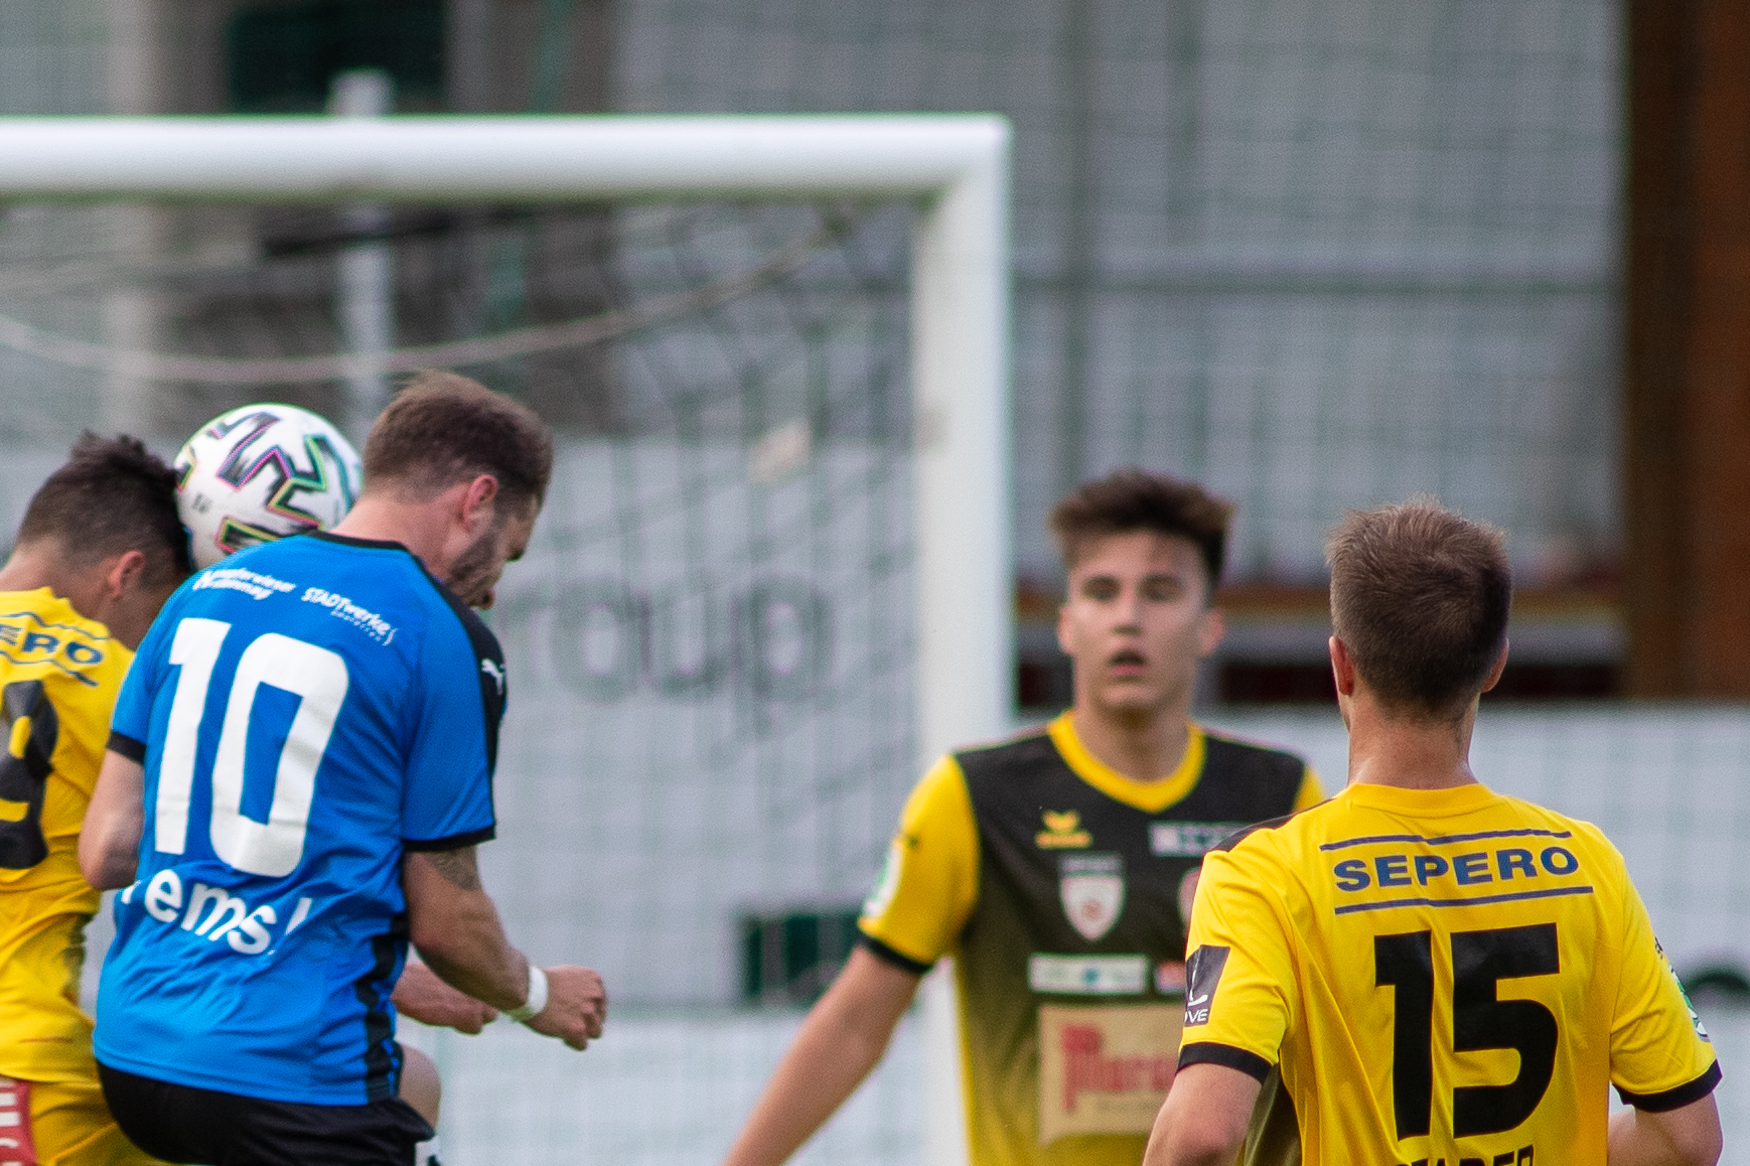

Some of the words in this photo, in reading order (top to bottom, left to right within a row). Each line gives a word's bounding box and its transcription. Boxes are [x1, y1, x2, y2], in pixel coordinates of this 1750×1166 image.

[154, 617, 349, 878] 10
[1333, 846, 1580, 892] SEPERO
[1374, 922, 1561, 1141] 15
